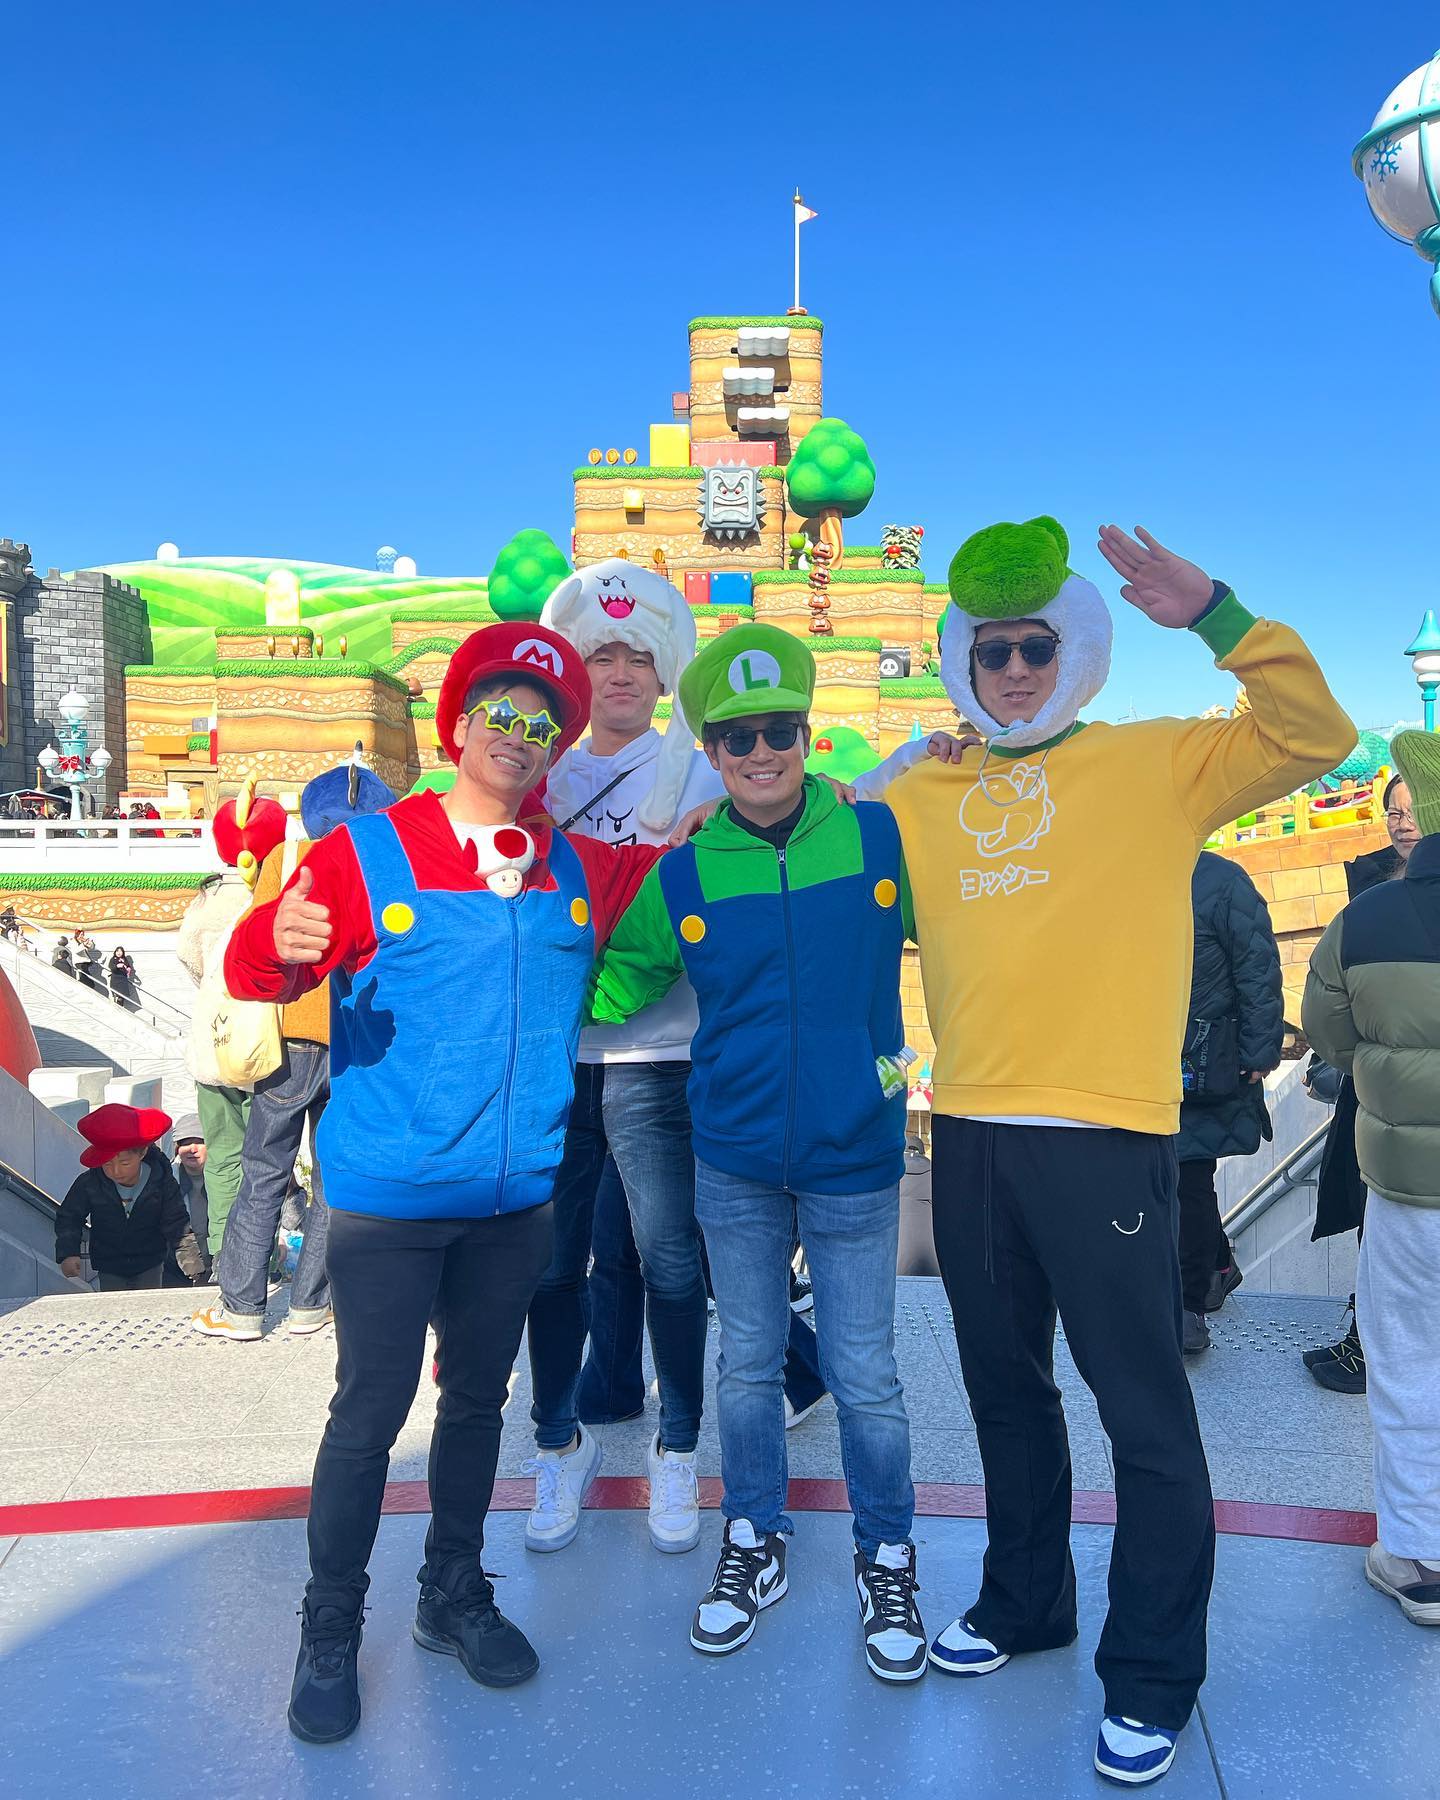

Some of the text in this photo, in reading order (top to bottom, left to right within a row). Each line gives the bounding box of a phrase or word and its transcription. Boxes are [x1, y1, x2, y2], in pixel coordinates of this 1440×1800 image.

[516, 645, 555, 675] M
[740, 658, 770, 690] L
[959, 862, 1050, 901] ヨッシー
